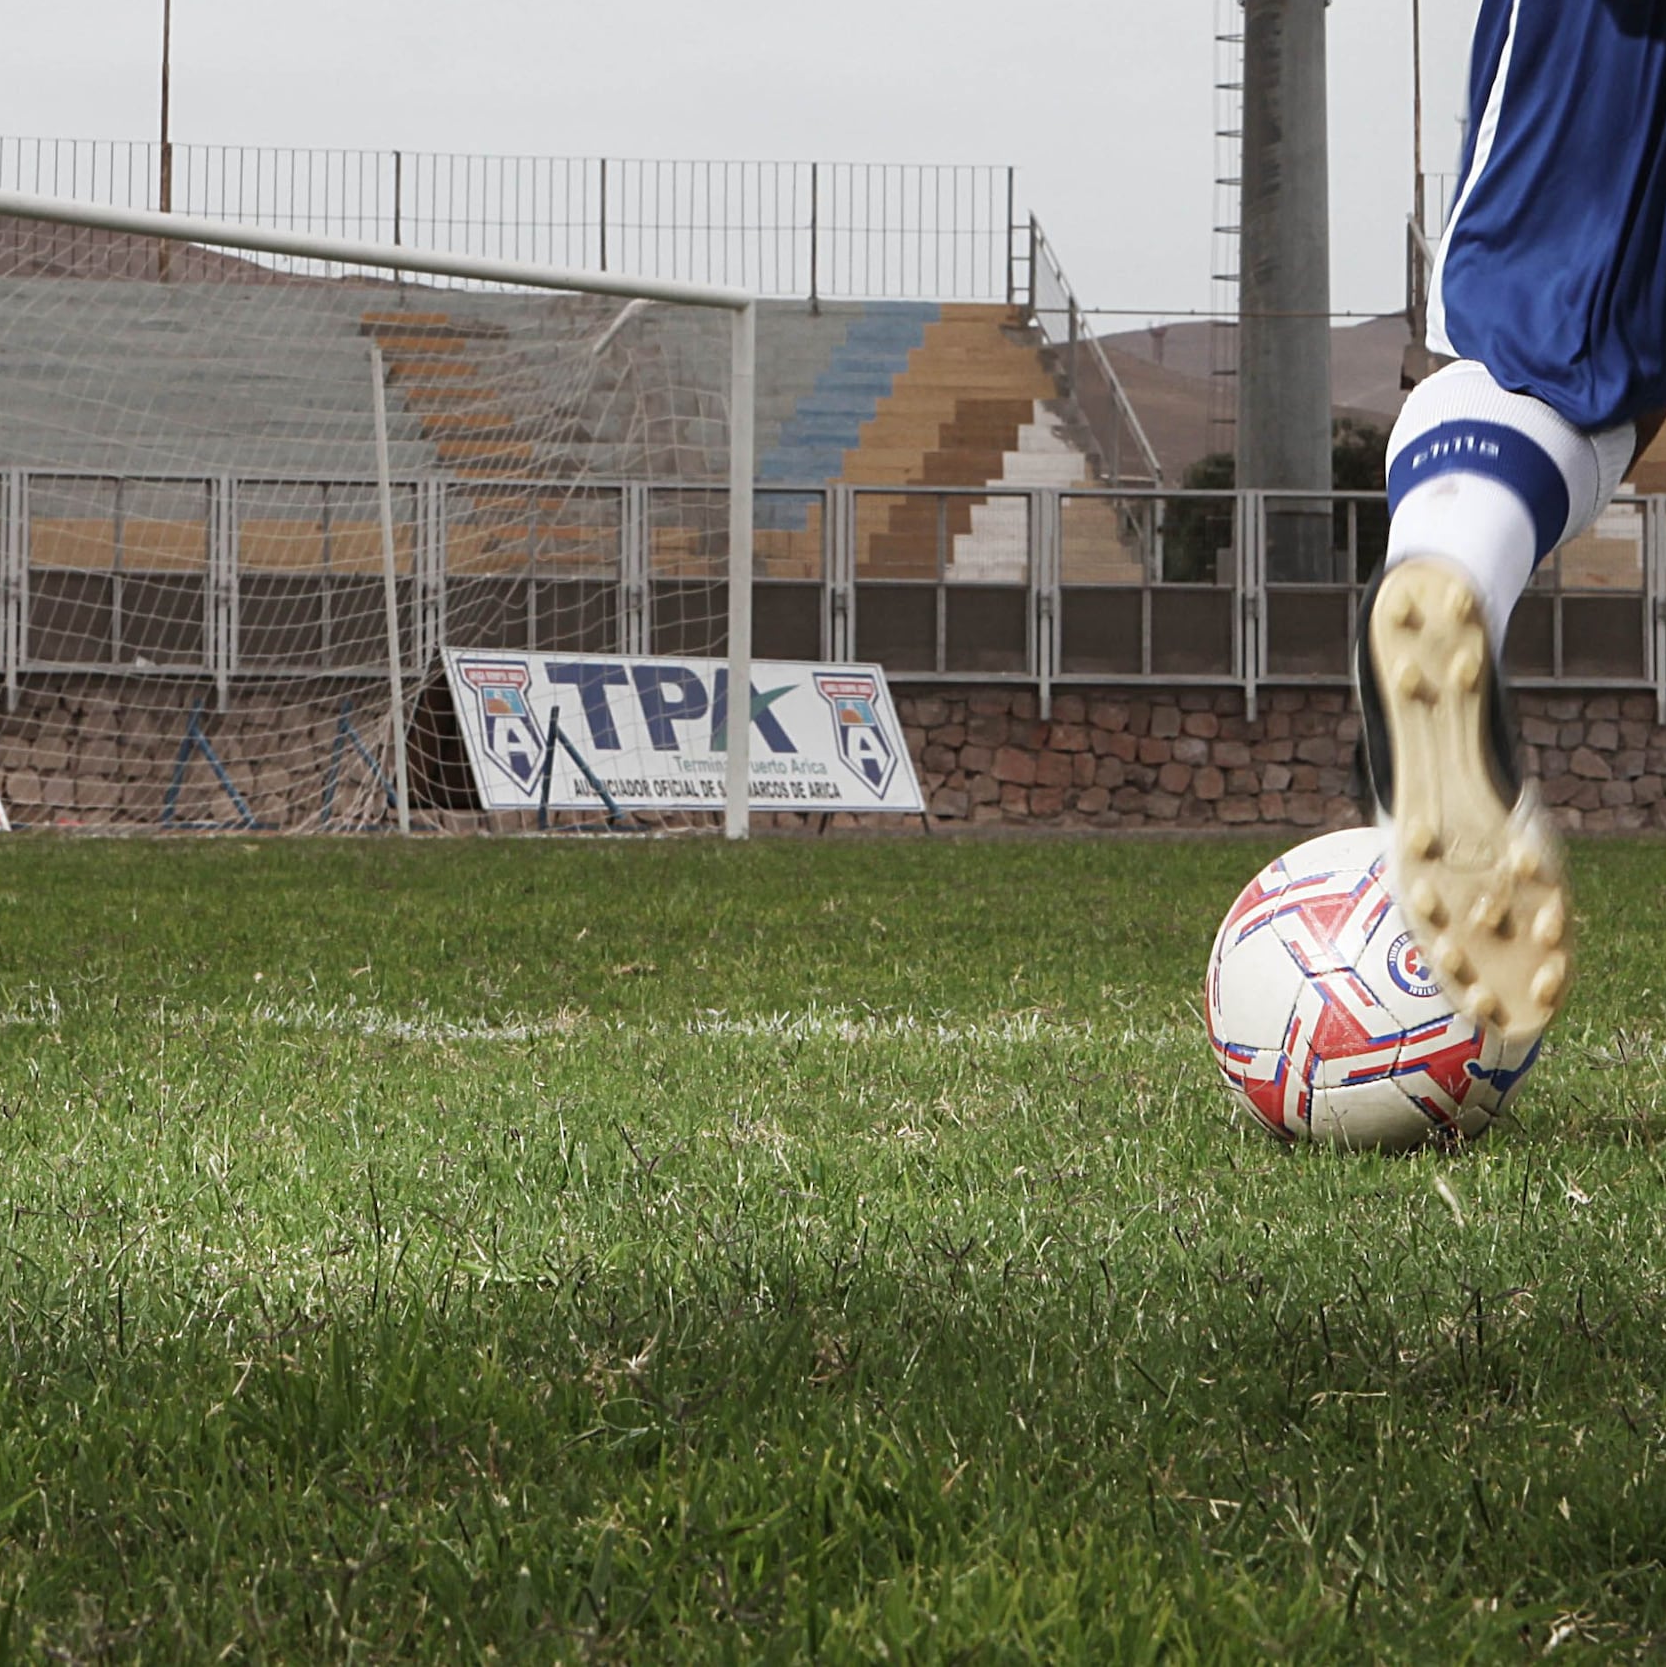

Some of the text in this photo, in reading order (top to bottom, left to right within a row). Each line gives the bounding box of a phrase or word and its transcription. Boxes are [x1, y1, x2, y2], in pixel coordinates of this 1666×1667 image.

[673, 755, 828, 774] Termin uerto Arica
[653, 779, 700, 798] OFICIAL
[699, 780, 717, 797] DE
[789, 781, 807, 798] DE
[807, 781, 842, 799] ARICA
